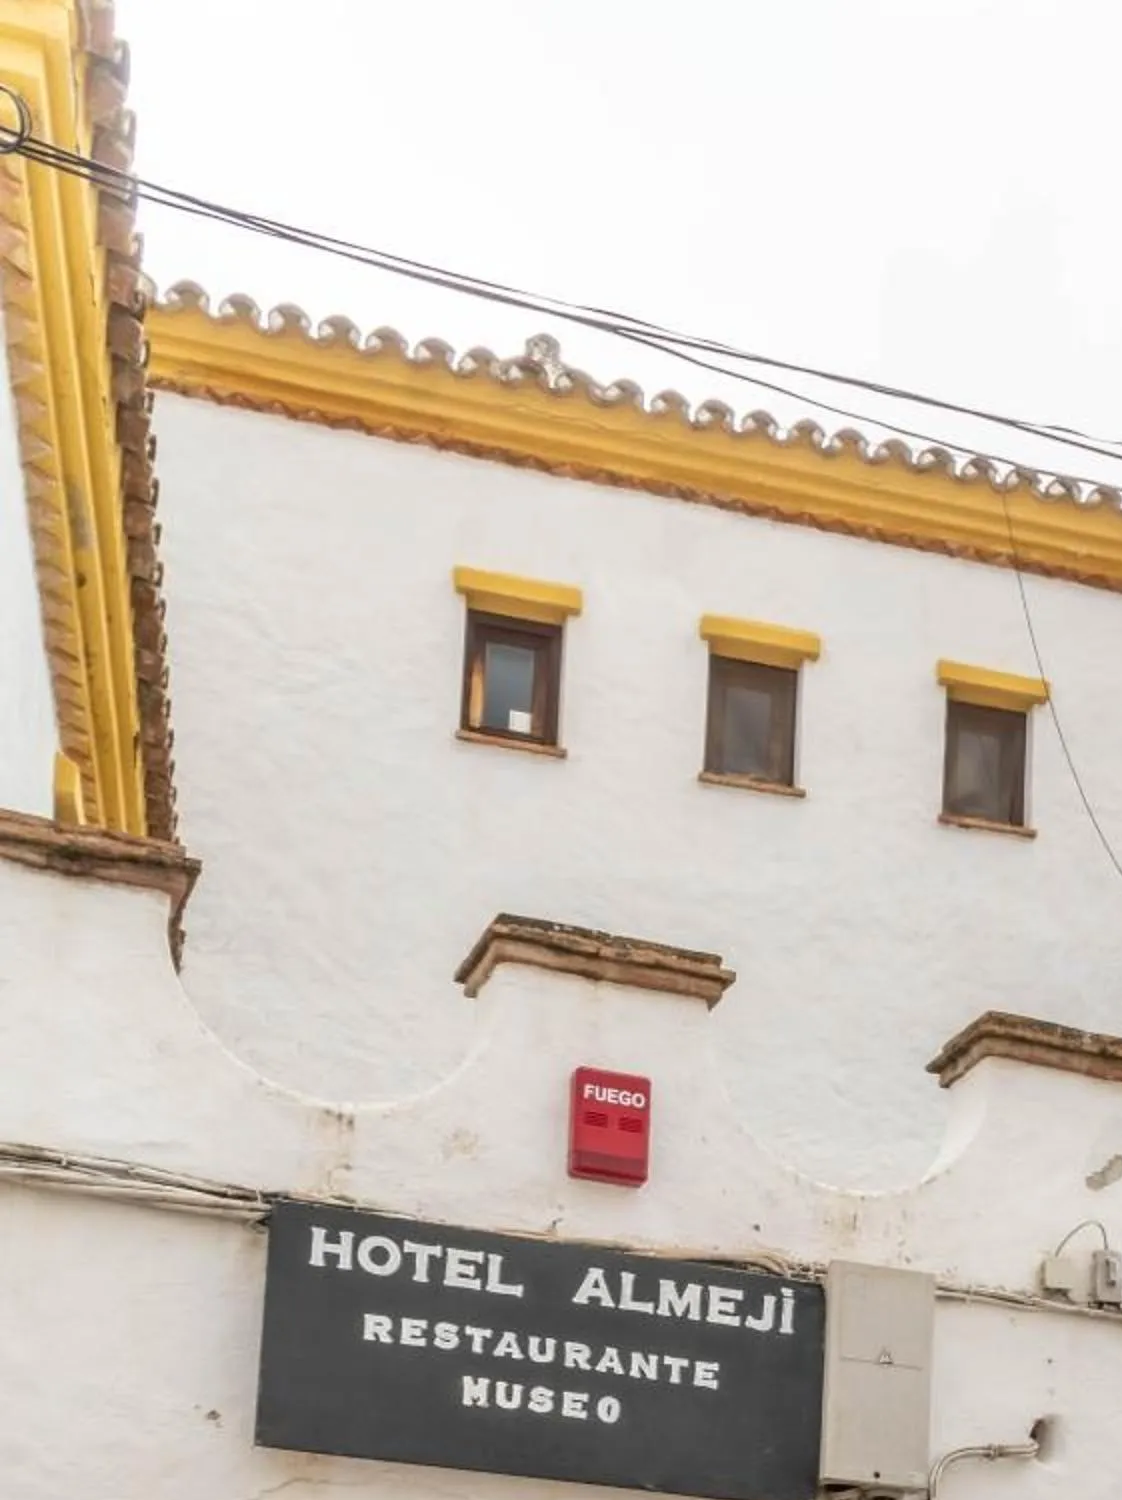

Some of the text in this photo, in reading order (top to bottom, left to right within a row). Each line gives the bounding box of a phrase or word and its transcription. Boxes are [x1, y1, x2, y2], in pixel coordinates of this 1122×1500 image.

[583, 1083, 646, 1108] FUEGO
[310, 1226, 525, 1298] HOTEL
[363, 1313, 721, 1390] RESTAURANTE
[462, 1375, 622, 1424] MUSEO
